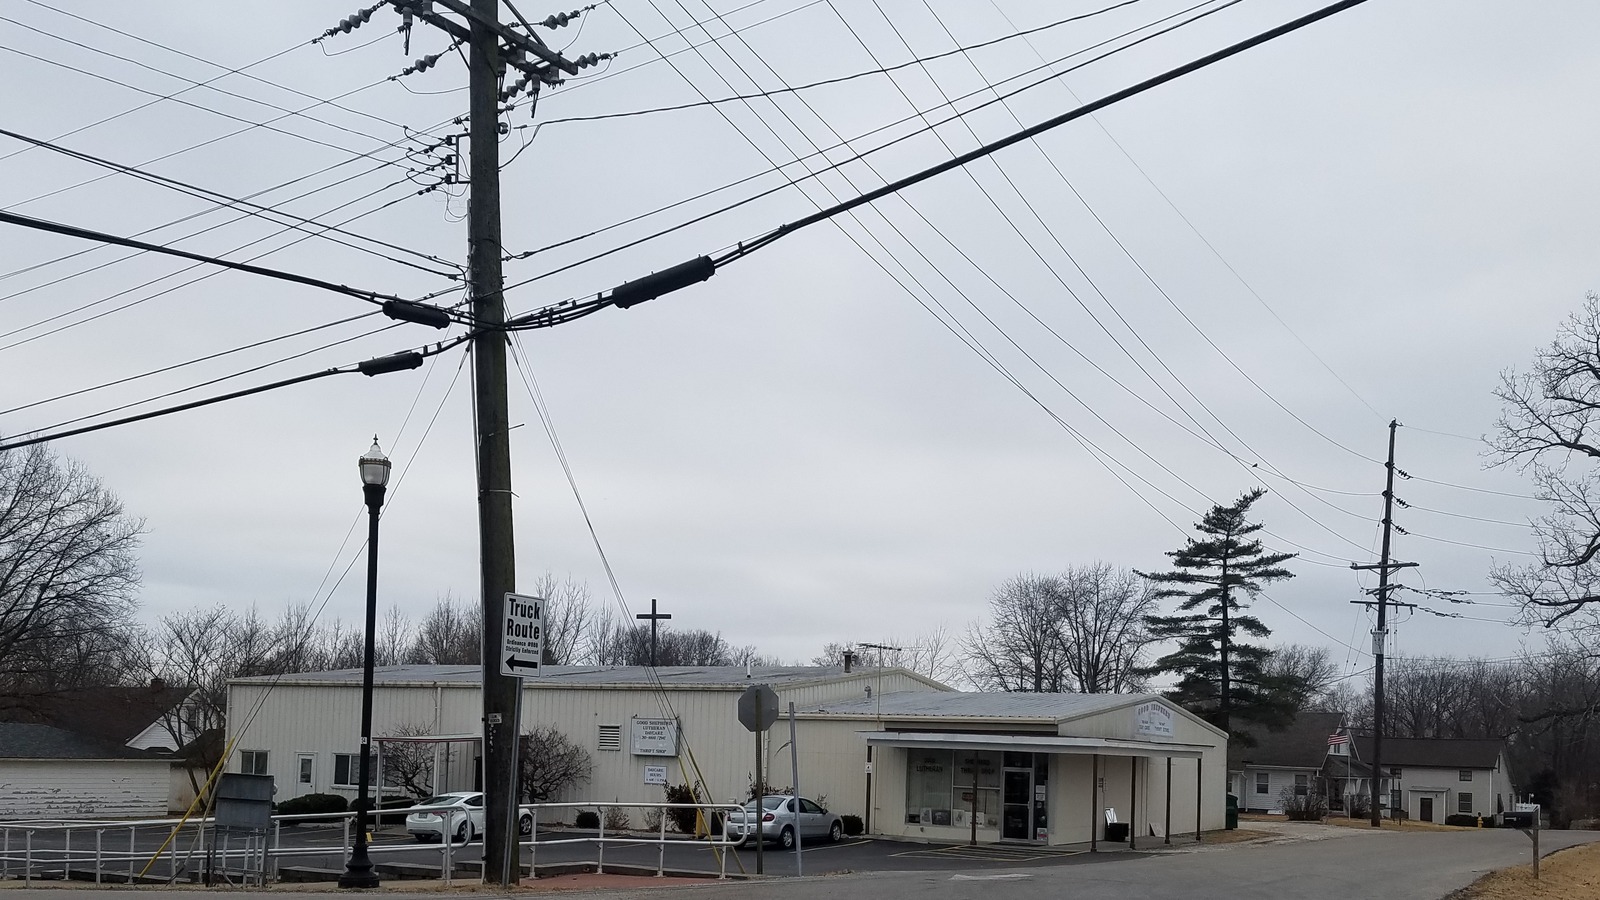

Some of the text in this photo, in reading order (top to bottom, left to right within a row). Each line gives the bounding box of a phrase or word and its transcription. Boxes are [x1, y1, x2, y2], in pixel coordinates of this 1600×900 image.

[509, 598, 540, 620] Truck
[506, 618, 540, 640] Route
[507, 638, 526, 647] Ordinance
[505, 645, 521, 653] Strictly
[916, 765, 943, 773] LUTHERAN
